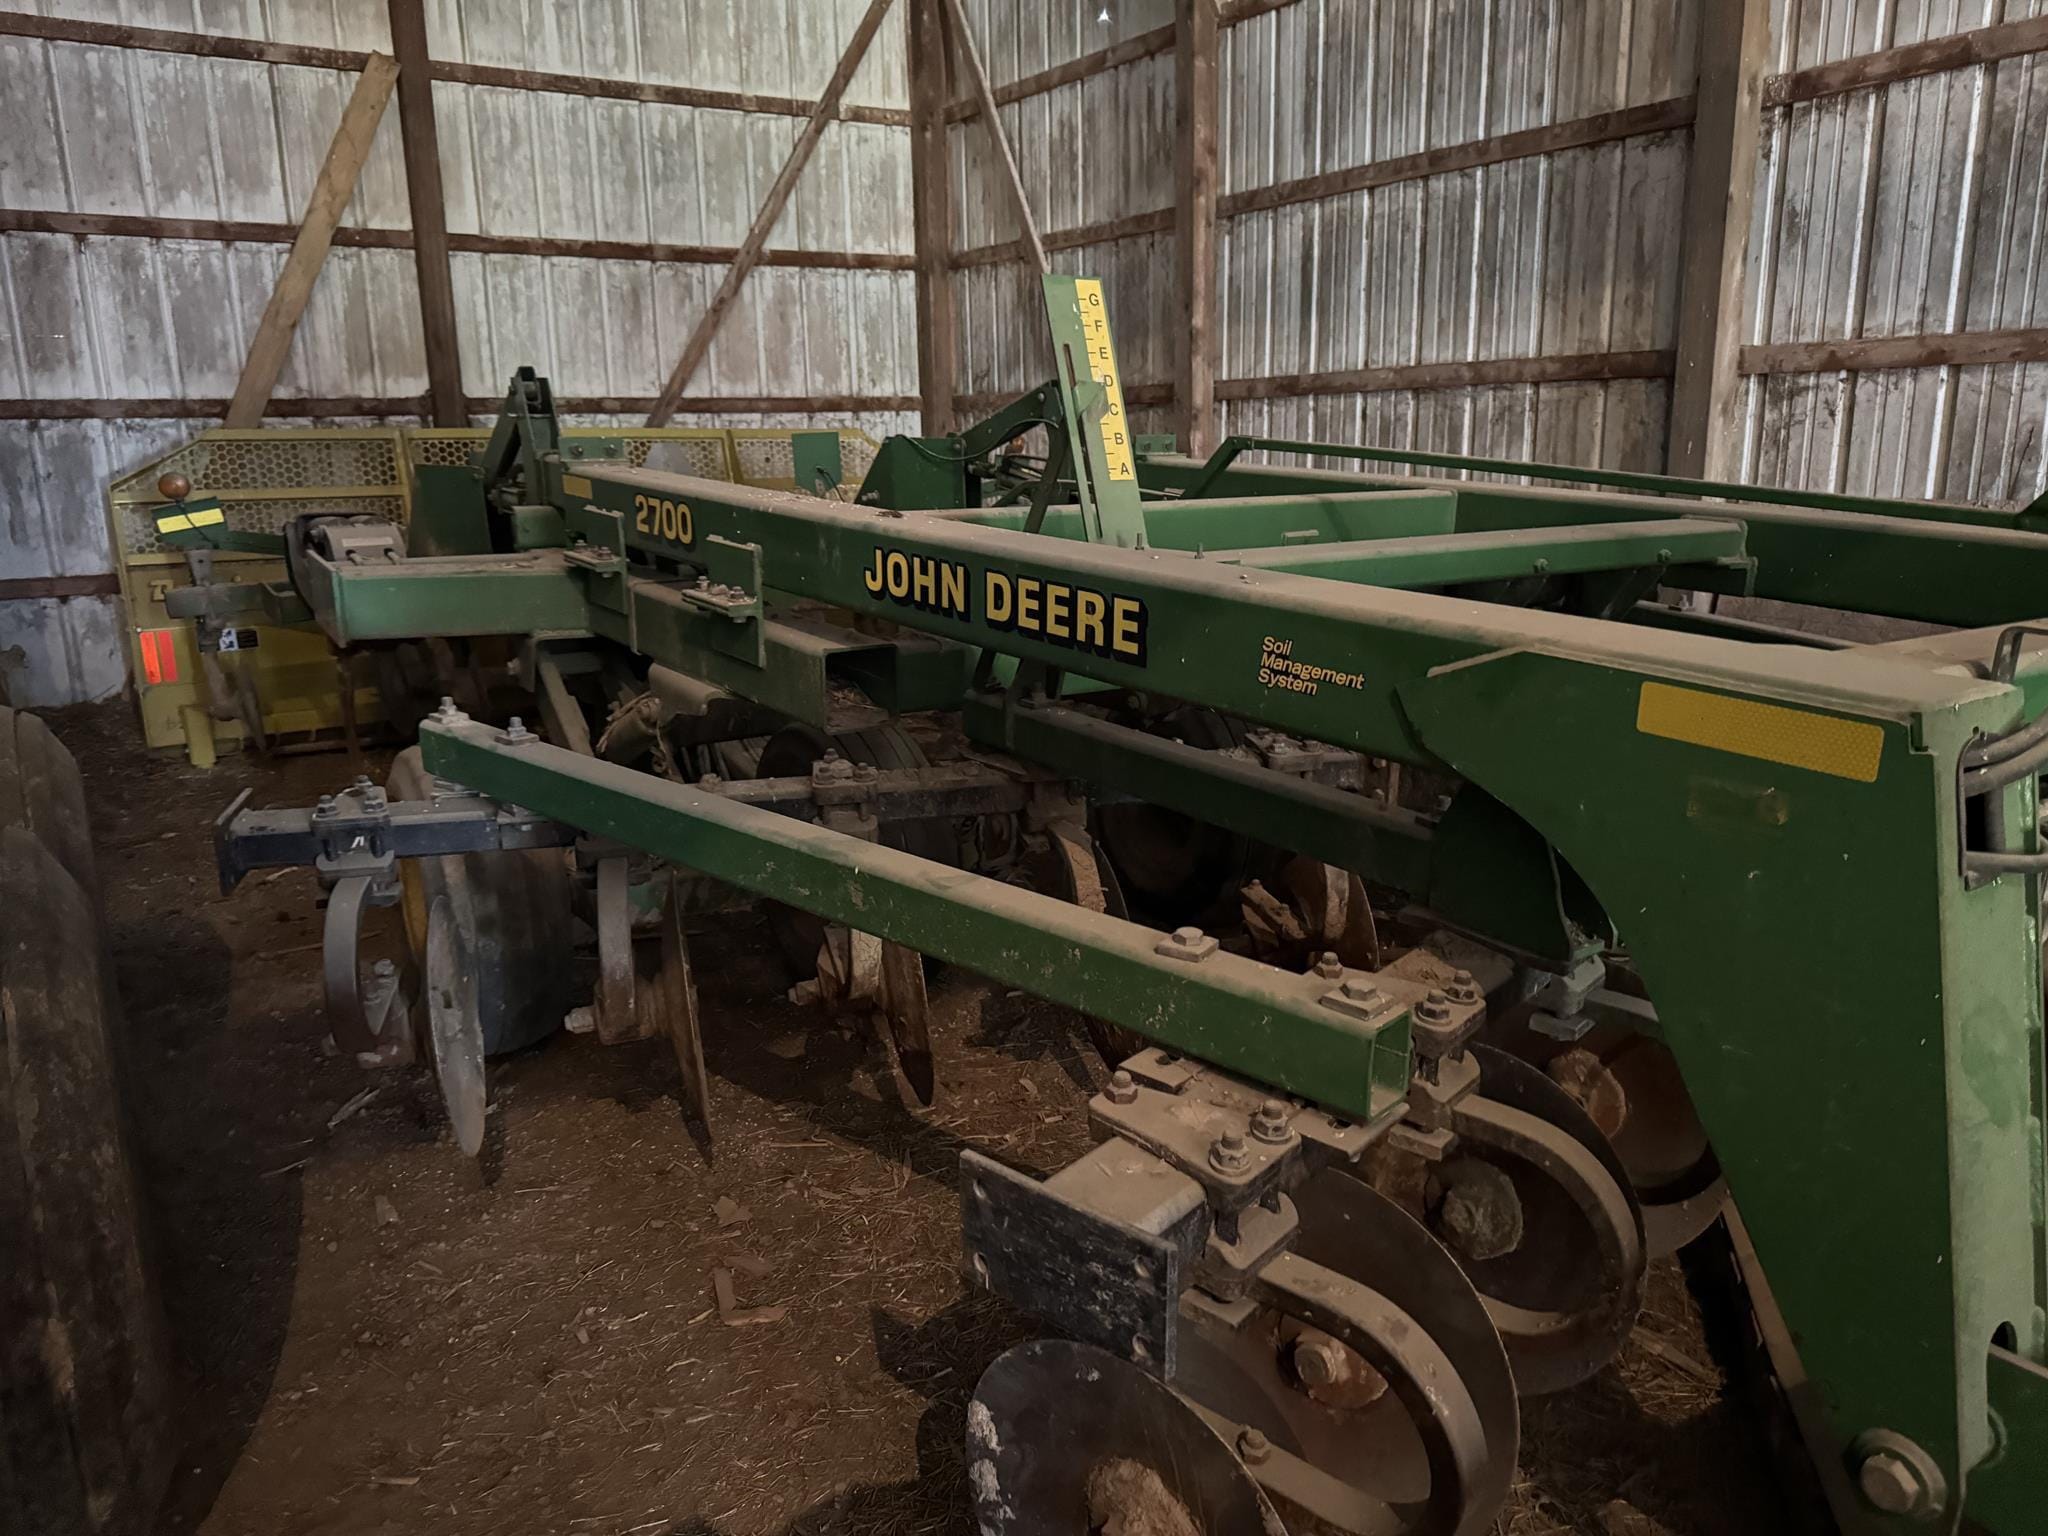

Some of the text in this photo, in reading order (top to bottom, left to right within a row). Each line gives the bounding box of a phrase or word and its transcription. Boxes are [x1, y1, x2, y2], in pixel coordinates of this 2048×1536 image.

[1088, 293, 1100, 307] G
[1094, 319, 1103, 332] F
[1099, 346, 1109, 360] E
[1103, 374, 1114, 387] D
[1109, 402, 1119, 416] C
[1114, 432, 1124, 445] B
[1119, 463, 1130, 476] A
[635, 494, 693, 545] 2700
[864, 548, 1143, 660] JOHN DEERE
[1262, 636, 1293, 656] Soil
[1260, 652, 1365, 690] Management
[1257, 668, 1318, 696] System
